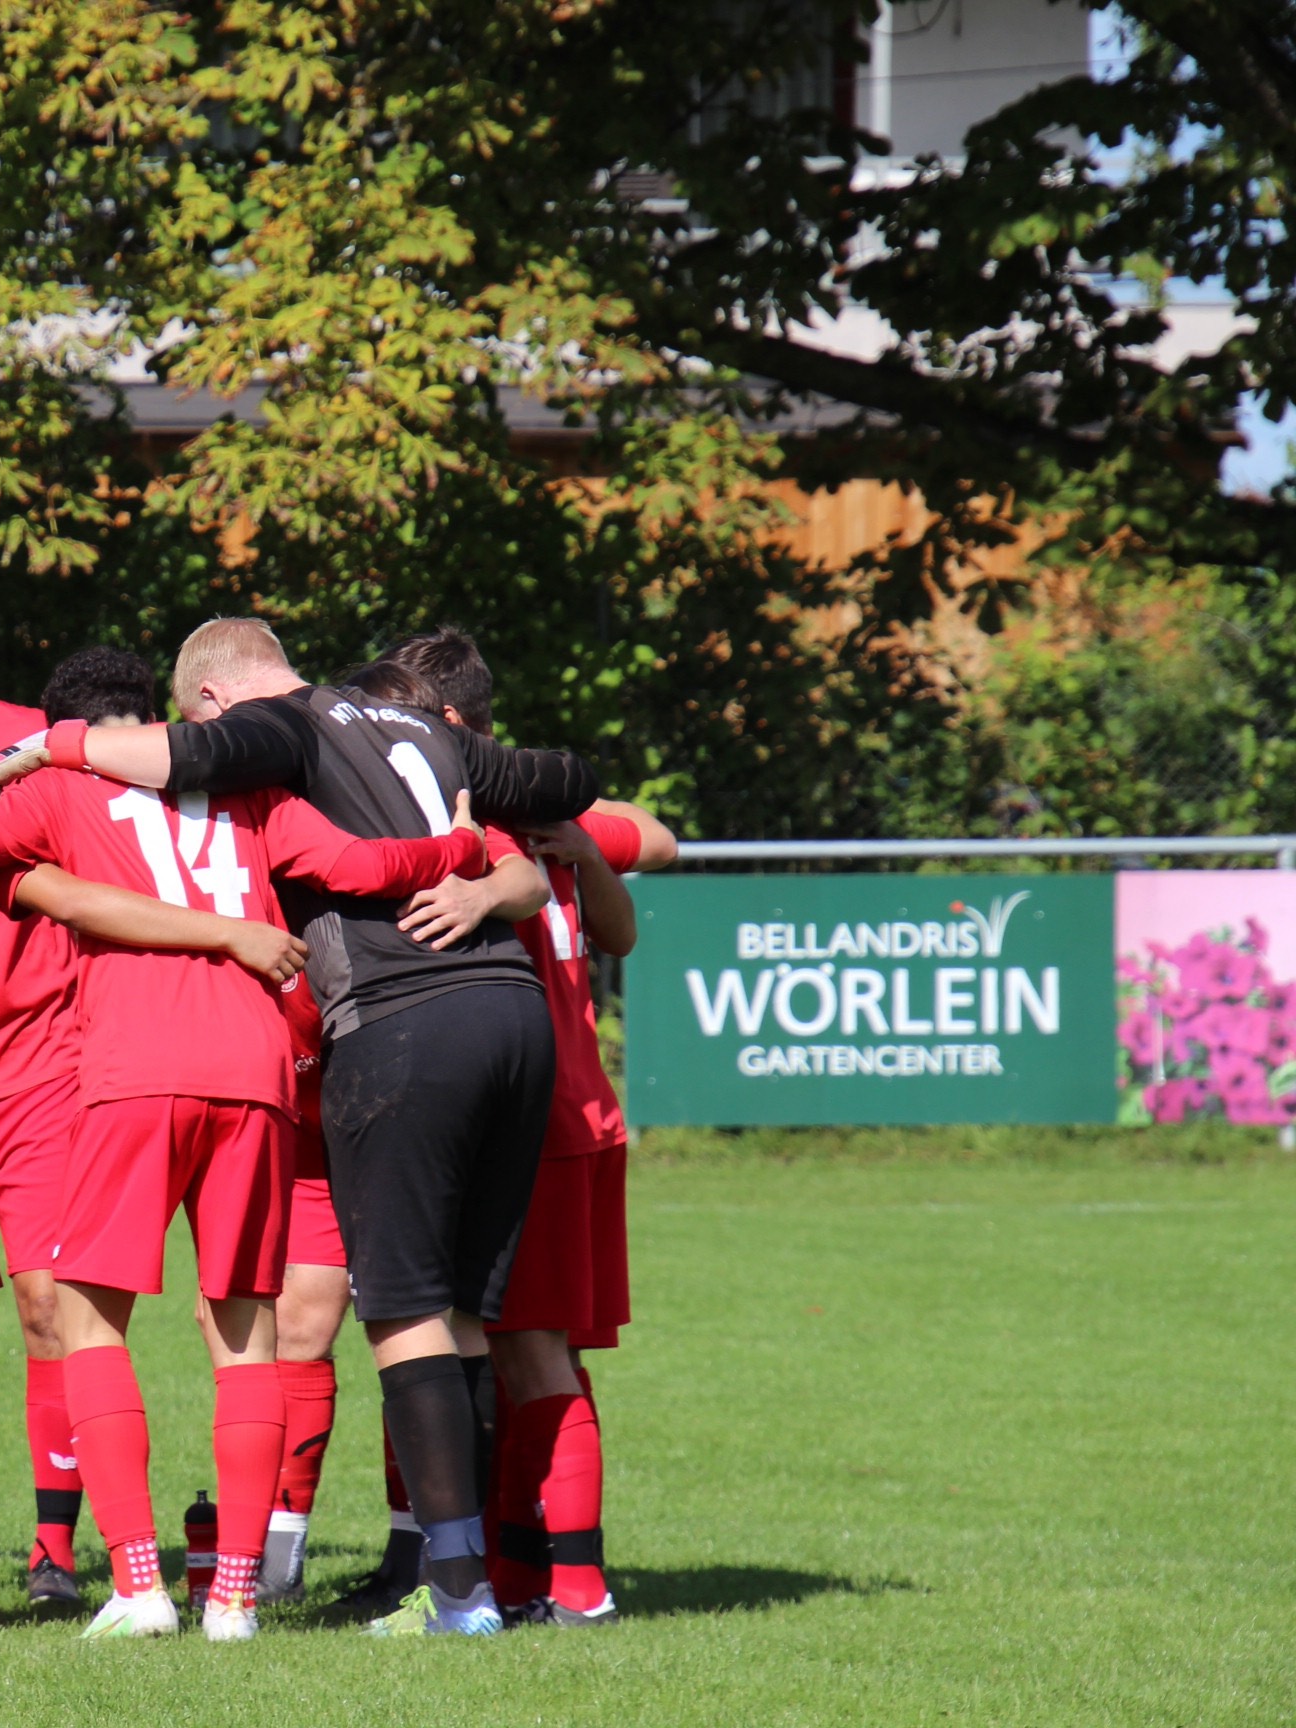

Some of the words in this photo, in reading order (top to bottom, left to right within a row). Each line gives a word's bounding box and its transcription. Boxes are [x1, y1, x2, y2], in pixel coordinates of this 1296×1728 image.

[387, 741, 452, 838] 1
[107, 786, 250, 918] 14
[737, 922, 978, 959] BELLANDRIS
[685, 962, 1061, 1037] WÖRLEIN
[737, 1044, 1004, 1076] GARTENCENTER
